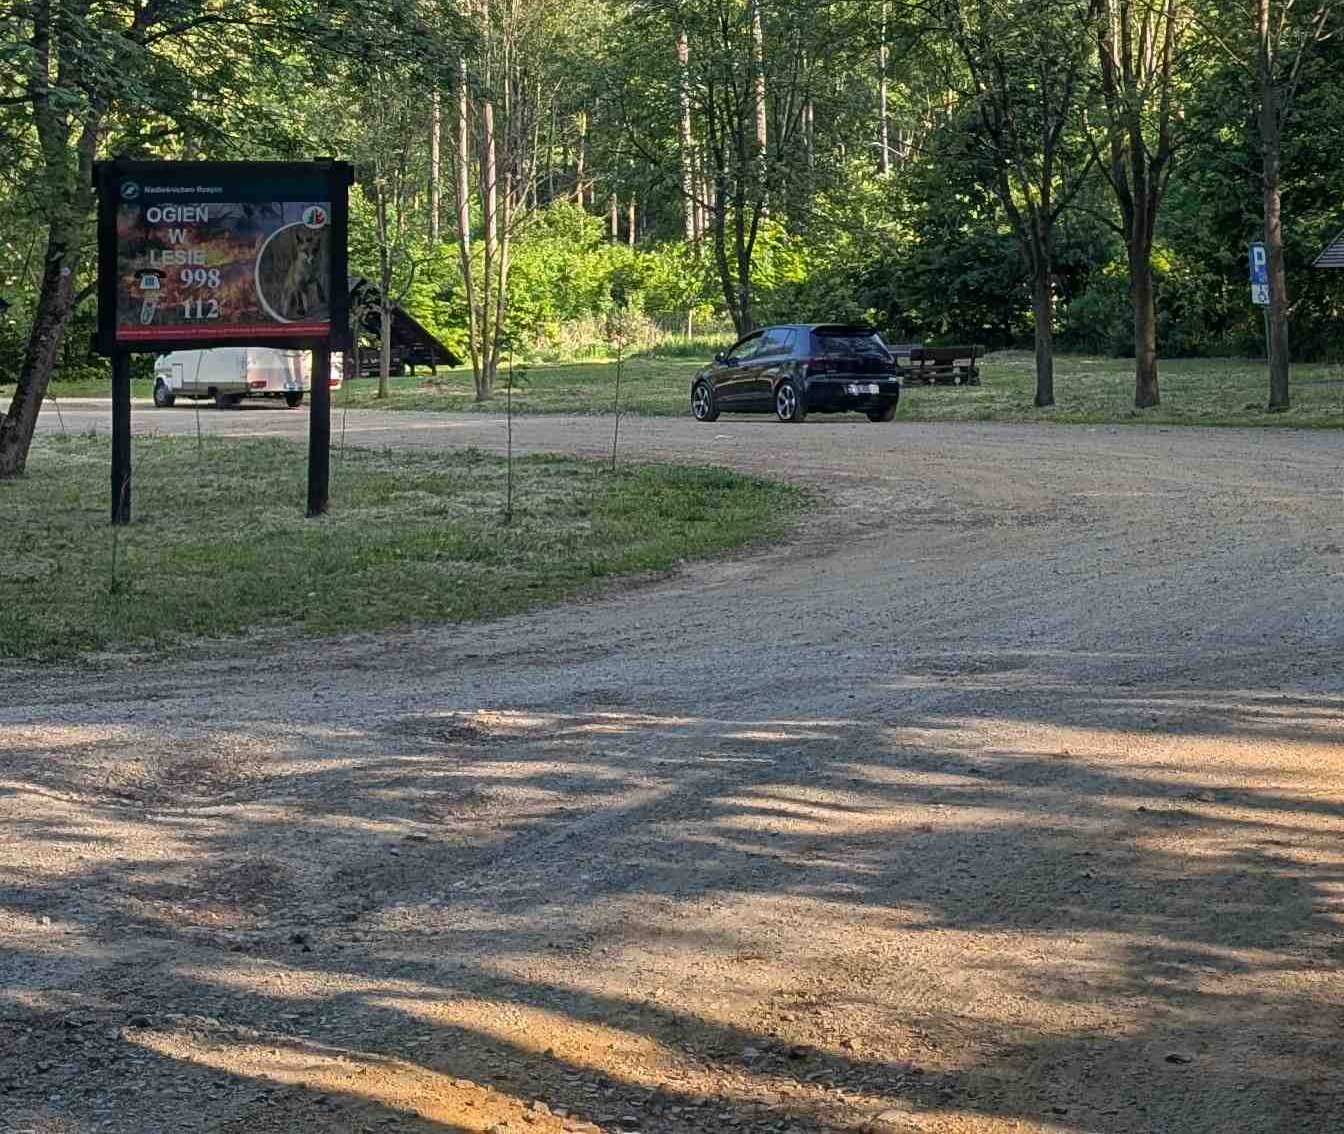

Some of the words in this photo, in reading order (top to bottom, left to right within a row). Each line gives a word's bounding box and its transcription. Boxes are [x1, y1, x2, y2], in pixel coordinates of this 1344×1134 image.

[168, 228, 187, 244] W
[150, 250, 205, 265] LESIE
[1253, 247, 1266, 272] P
[180, 268, 220, 288] 998
[183, 299, 218, 319] 112
